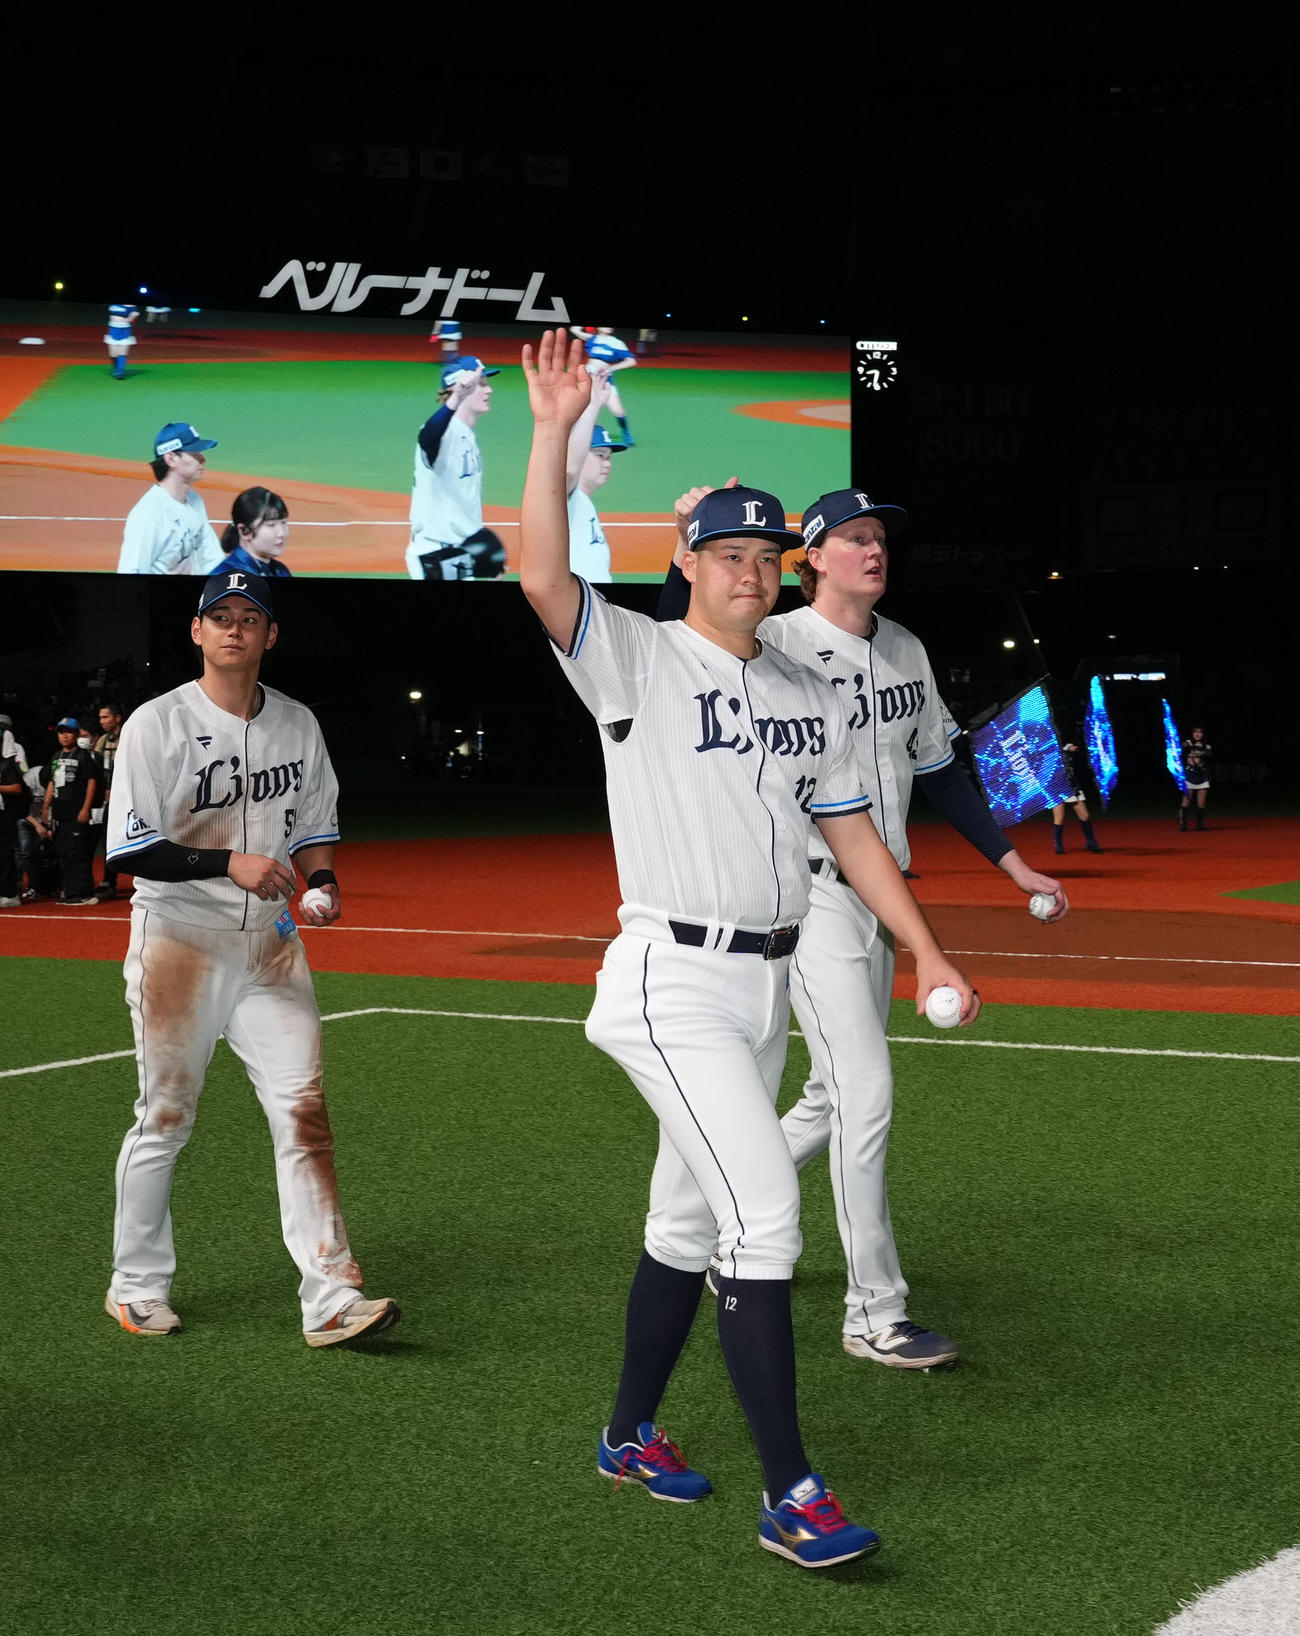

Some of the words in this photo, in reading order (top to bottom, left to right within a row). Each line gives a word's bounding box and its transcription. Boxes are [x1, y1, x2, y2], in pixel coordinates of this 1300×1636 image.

[258, 259, 571, 323] ベルーナドーム
[925, 427, 1021, 462] SOGO
[742, 500, 767, 527] L
[226, 572, 248, 590] L
[189, 755, 304, 815] Lions
[794, 774, 817, 815] 12
[284, 807, 297, 839] 5
[724, 1295, 738, 1312] 12
